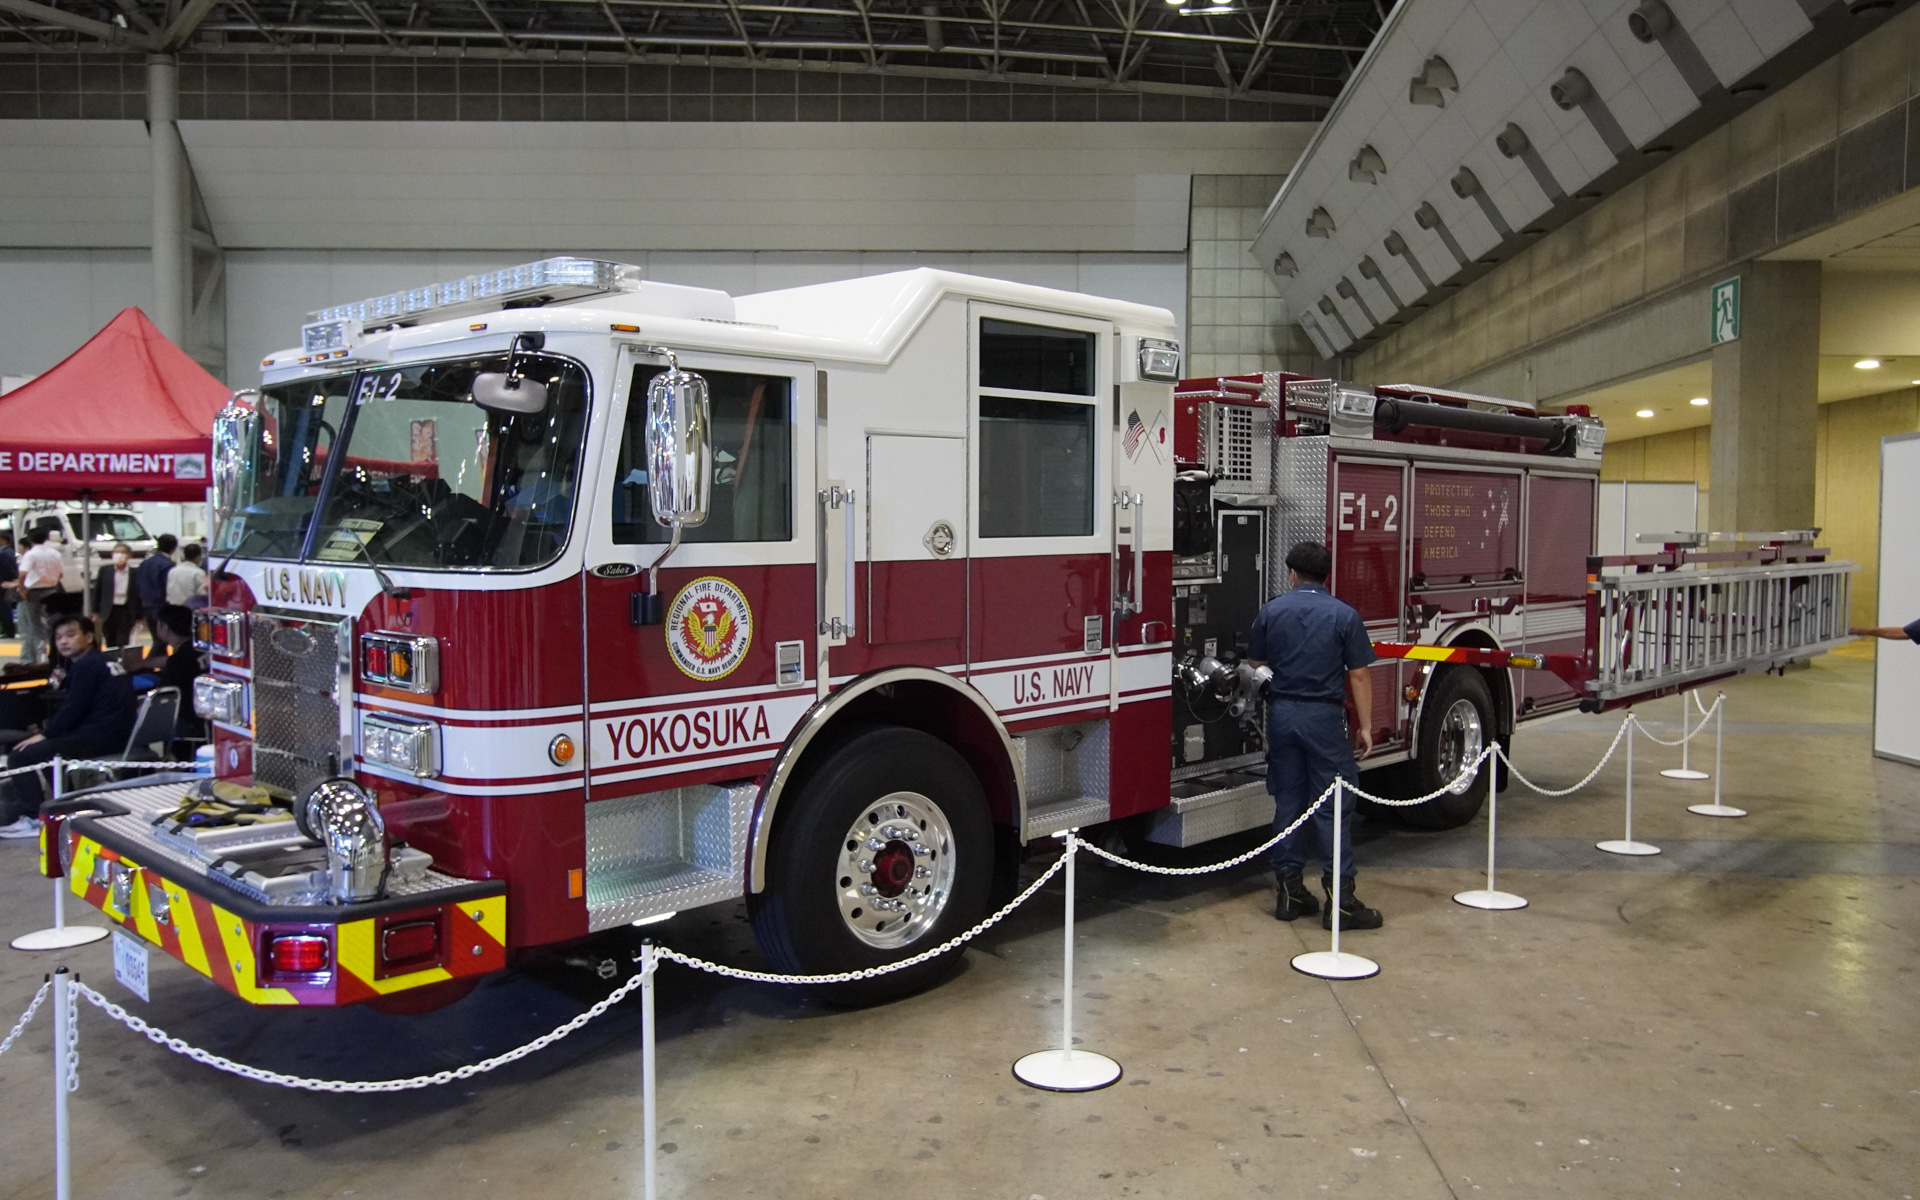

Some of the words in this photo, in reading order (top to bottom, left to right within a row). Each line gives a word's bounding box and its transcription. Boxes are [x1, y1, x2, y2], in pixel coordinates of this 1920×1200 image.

[355, 372, 402, 405] E1-2
[18, 452, 174, 473] DEPARTMENT
[1424, 483, 1474, 497] PROTECTING
[1339, 492, 1398, 532] E1-2
[1424, 504, 1451, 517] THOSE
[1454, 505, 1471, 517] WHO
[1424, 525, 1455, 538] DEFEND
[1423, 546, 1459, 559] AMERICA
[264, 567, 296, 602] U.S.
[298, 570, 349, 609] NAVY
[670, 591, 694, 631] REGIONAL
[694, 582, 712, 594] FIRE
[714, 582, 748, 626] DEPARTMENT
[671, 641, 696, 674] COMMANDER
[696, 667, 707, 675] U.S.
[708, 666, 721, 675] NAVY
[722, 654, 739, 670] REGION
[737, 636, 747, 656] JAPAN
[1014, 671, 1046, 705] U.S.
[1053, 664, 1094, 698] NAVY
[606, 705, 771, 761] YOKOSUKA
